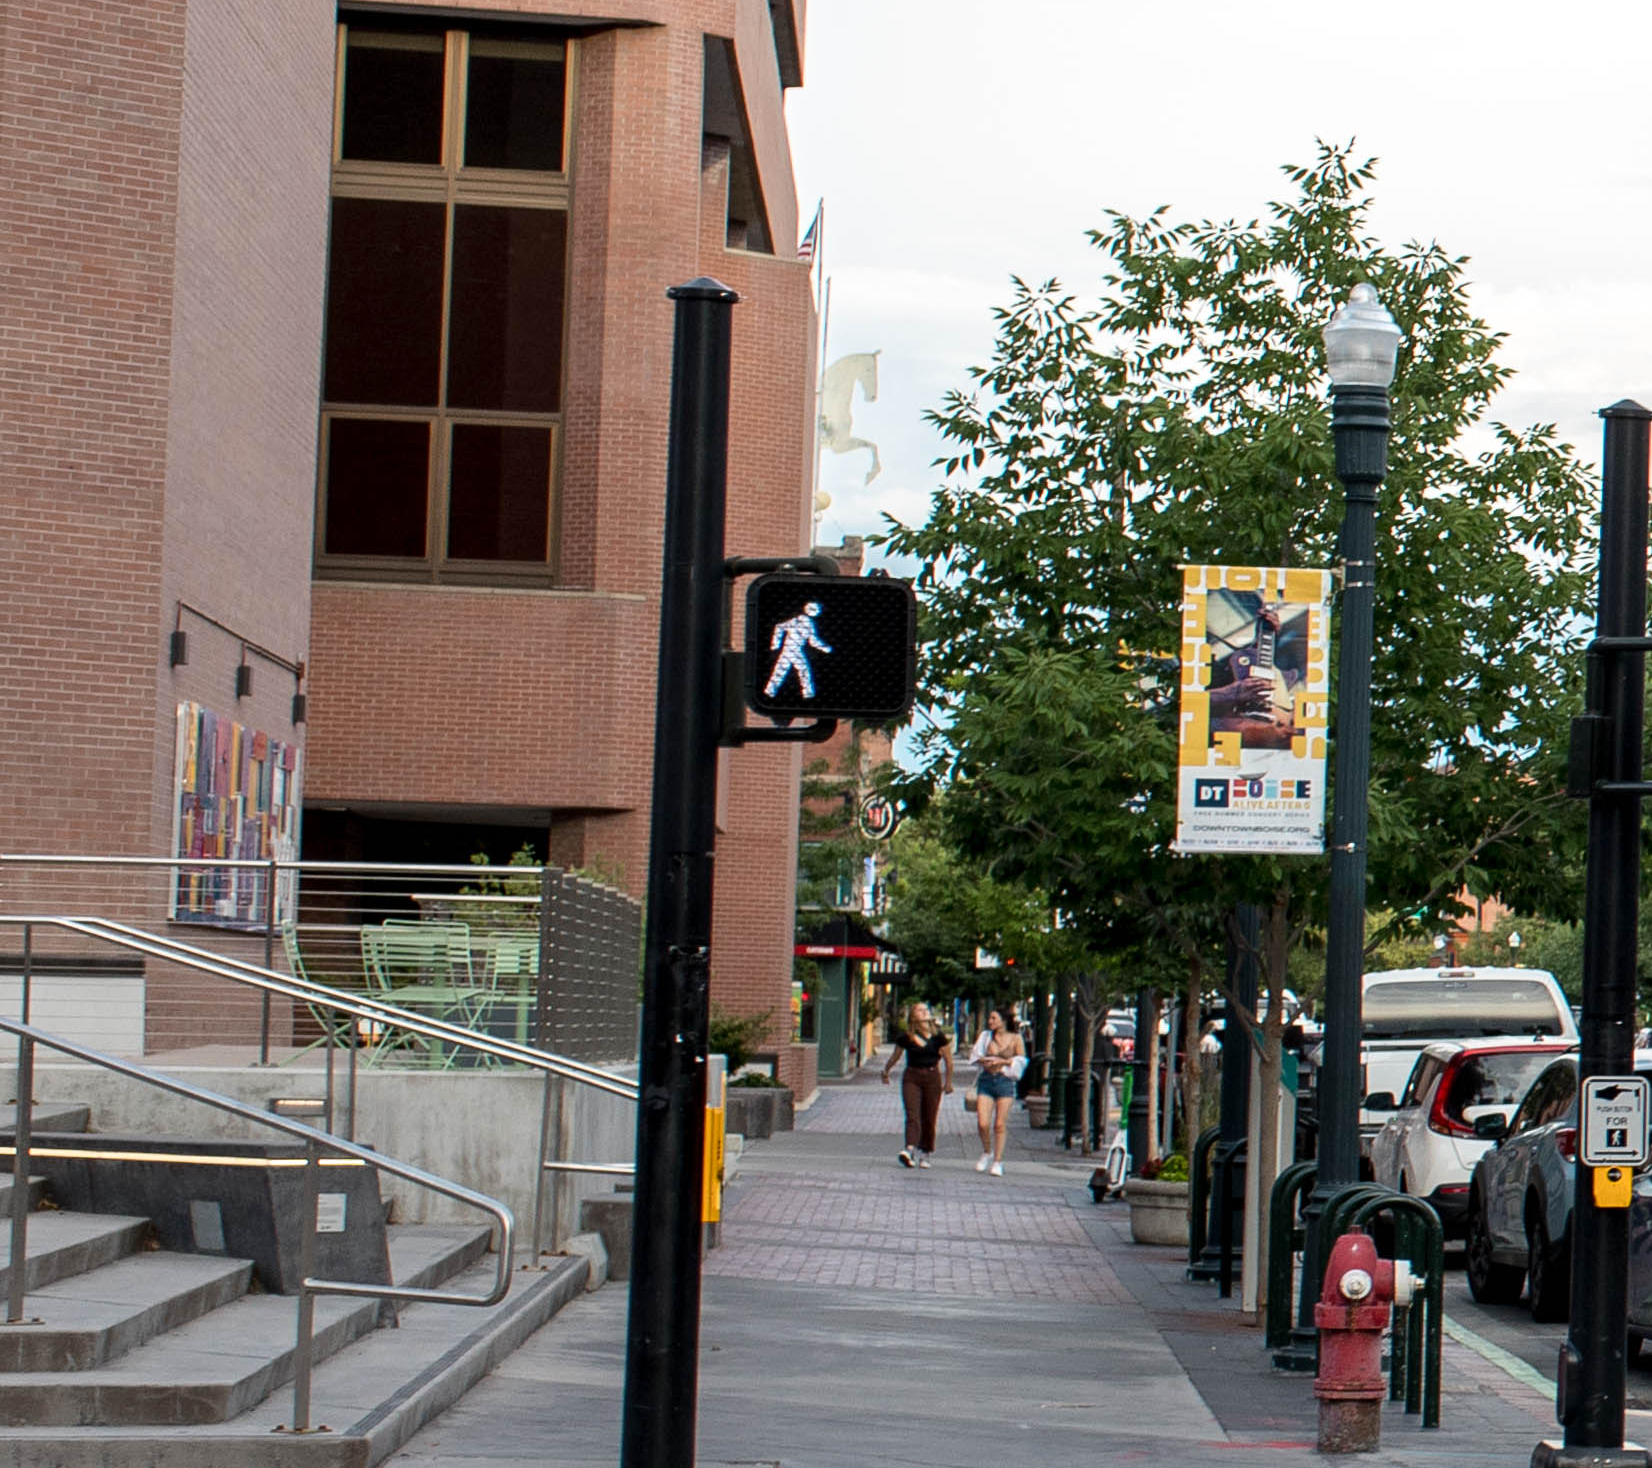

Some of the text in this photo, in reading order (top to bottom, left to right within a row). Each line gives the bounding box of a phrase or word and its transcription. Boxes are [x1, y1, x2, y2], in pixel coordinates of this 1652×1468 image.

[1200, 779, 1312, 801] DT BOISE
[1233, 800, 1265, 810] ALIVE
[1266, 801, 1301, 810] AFTER
[1606, 1117, 1628, 1126] FOR
